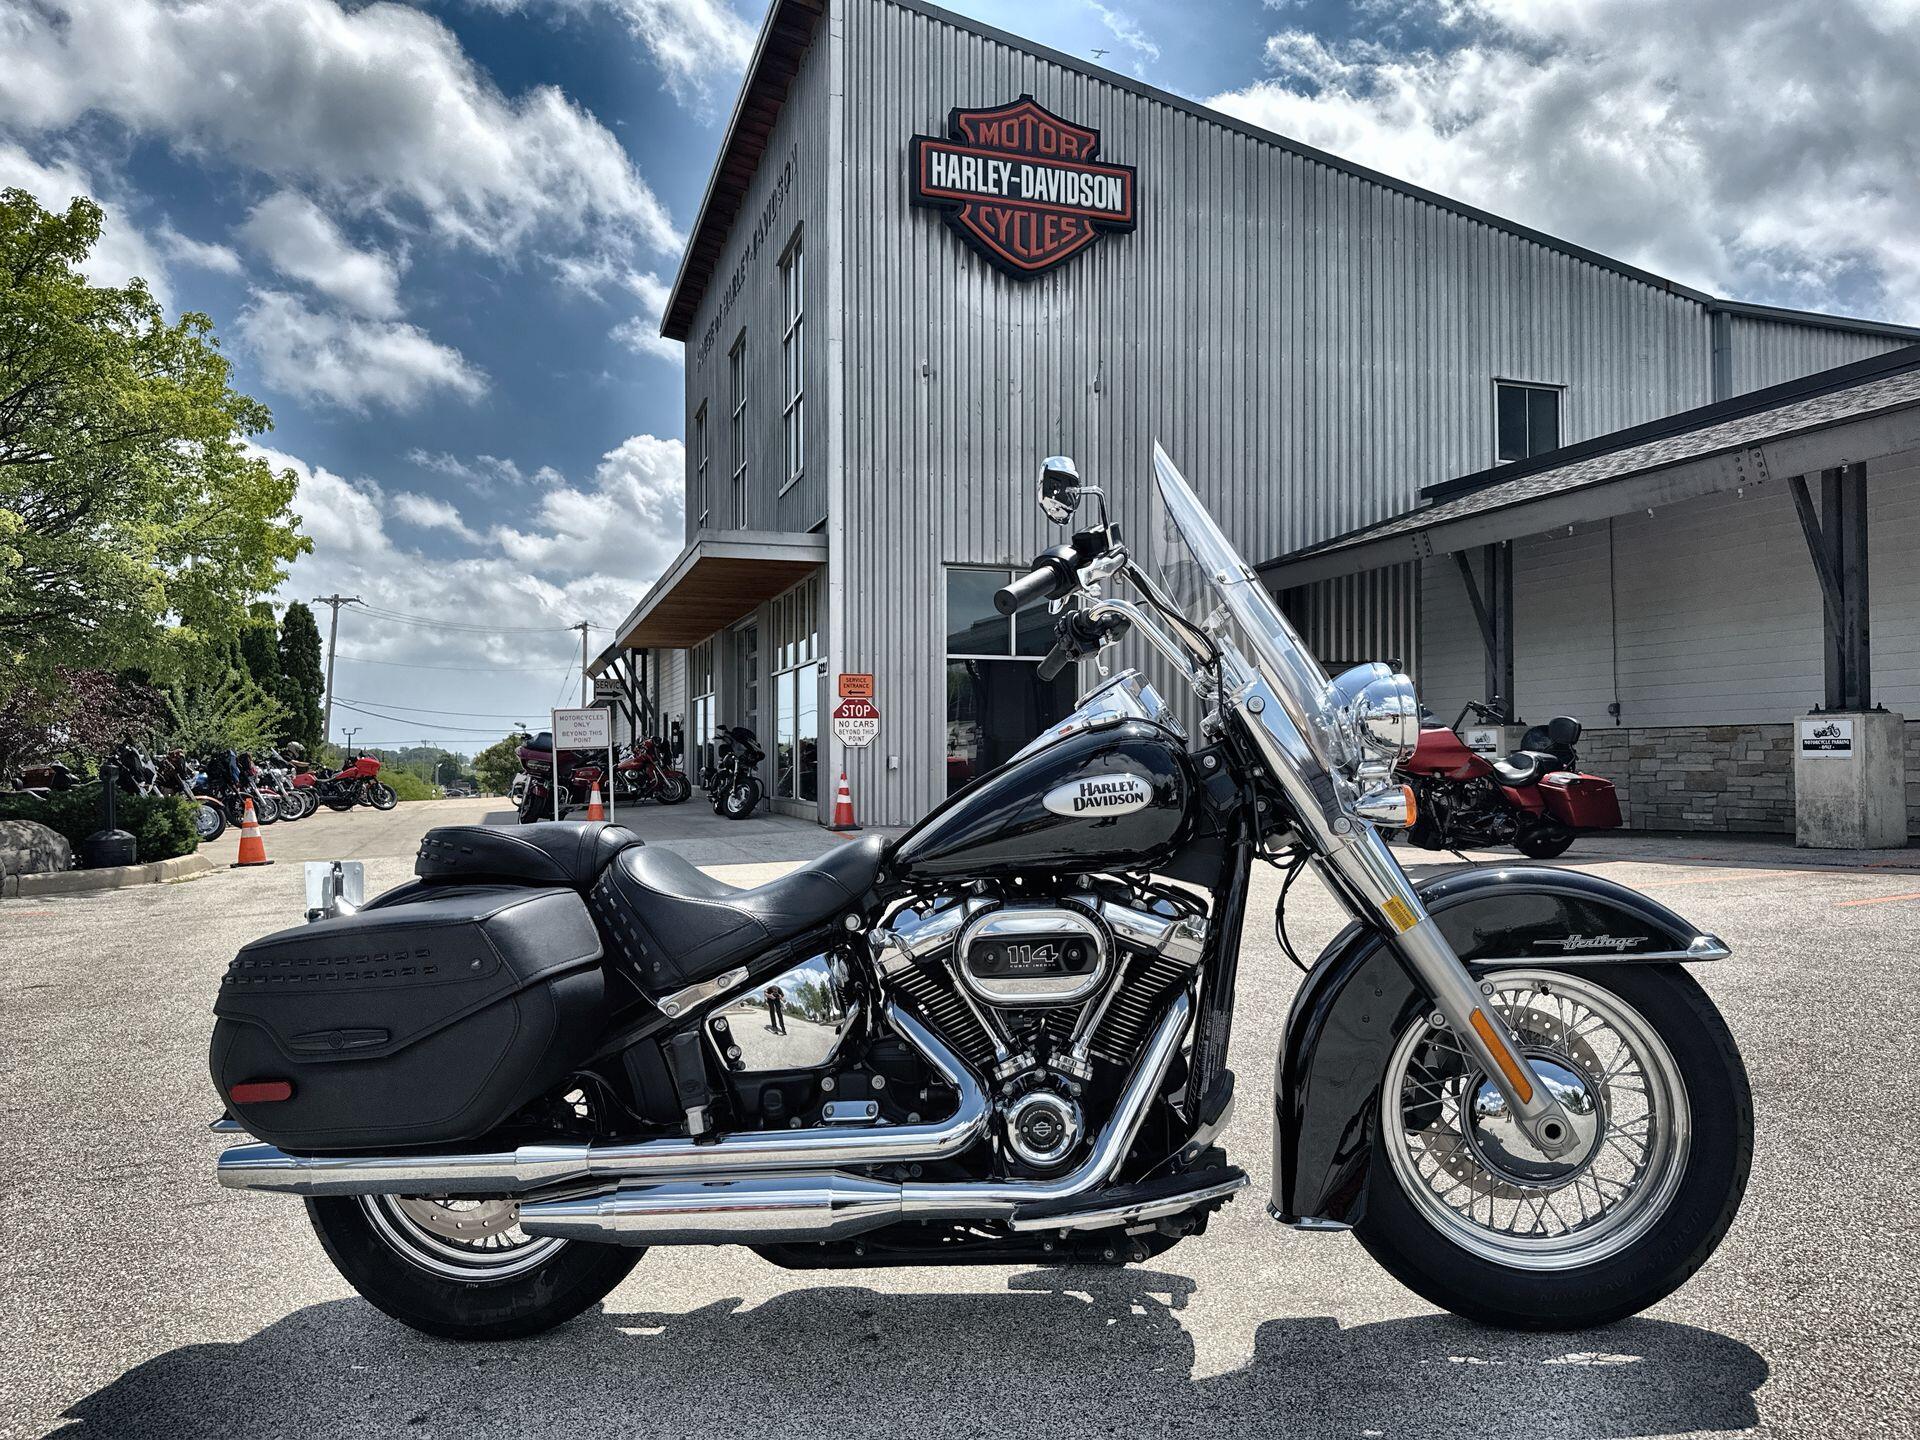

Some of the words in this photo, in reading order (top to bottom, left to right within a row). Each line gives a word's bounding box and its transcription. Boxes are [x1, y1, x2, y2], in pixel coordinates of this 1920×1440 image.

[979, 113, 1079, 160] MOTOR
[931, 151, 1123, 212] HARLEY-DAVIDSON
[979, 206, 1078, 258] CYCLES
[842, 704, 871, 717] STOP
[838, 720, 850, 728] NO
[853, 720, 875, 728] CARS
[1073, 792, 1145, 812] DAVIDSON
[1558, 934, 1648, 951] Heritage
[1007, 943, 1059, 964] 114
